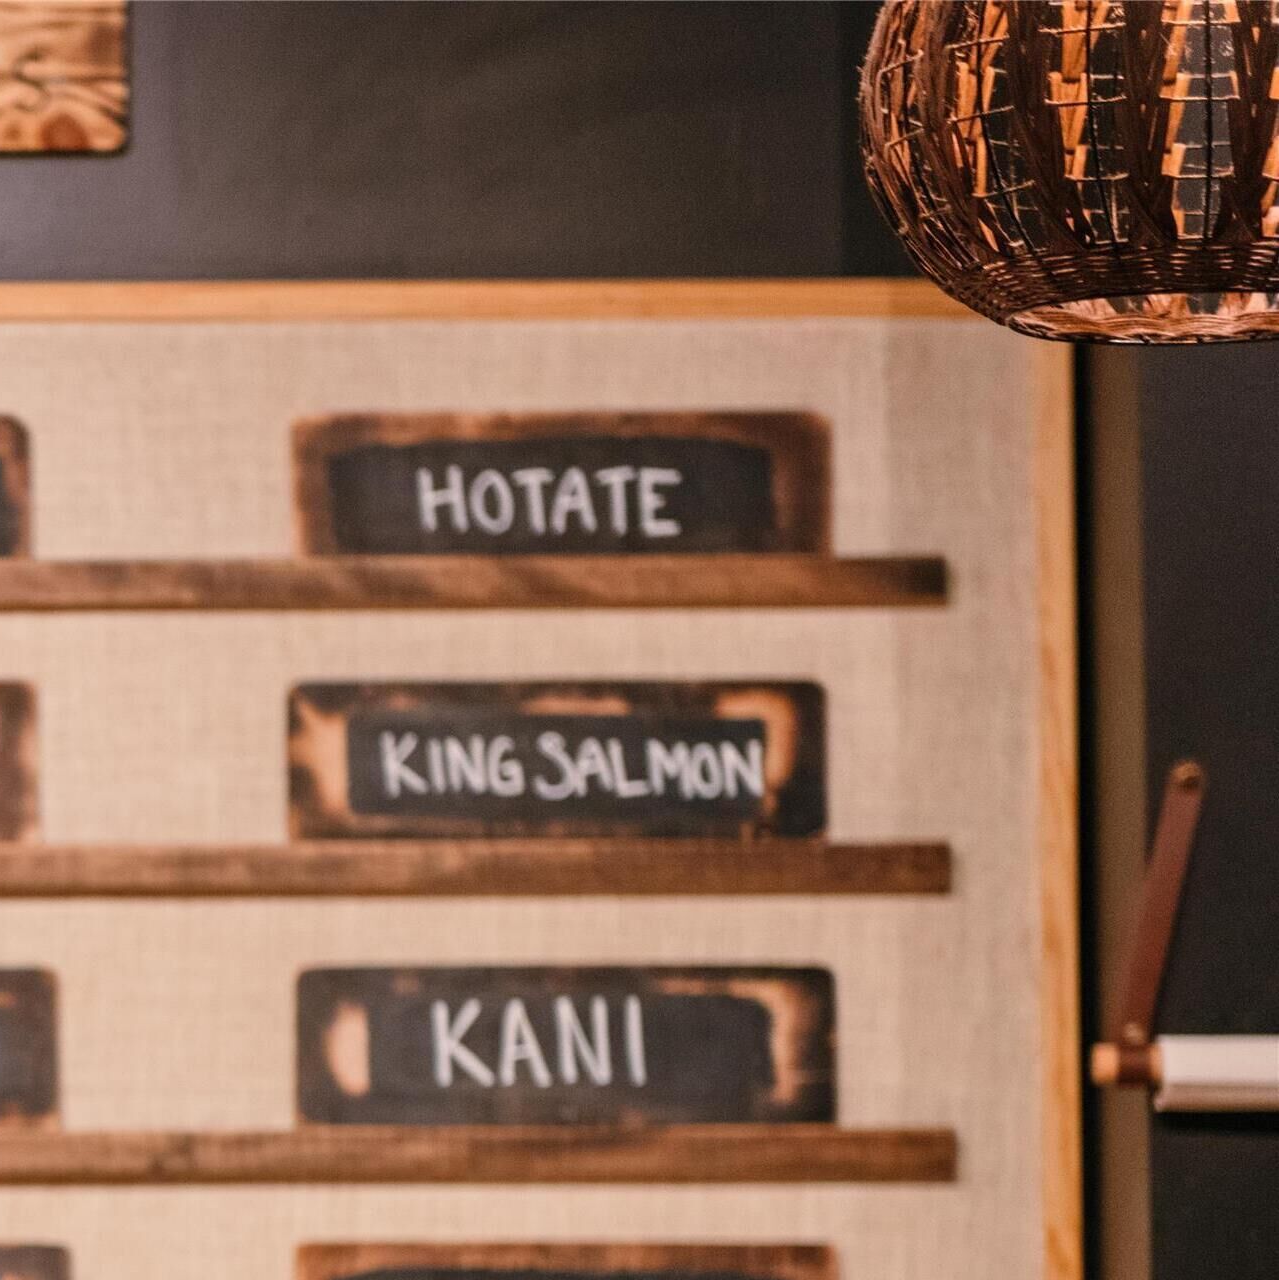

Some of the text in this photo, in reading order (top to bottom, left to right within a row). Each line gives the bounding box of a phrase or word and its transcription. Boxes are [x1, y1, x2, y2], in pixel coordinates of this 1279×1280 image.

[416, 465, 682, 538] HOTATE
[378, 732, 766, 799] KING SALMON
[430, 994, 649, 1089] KANI
